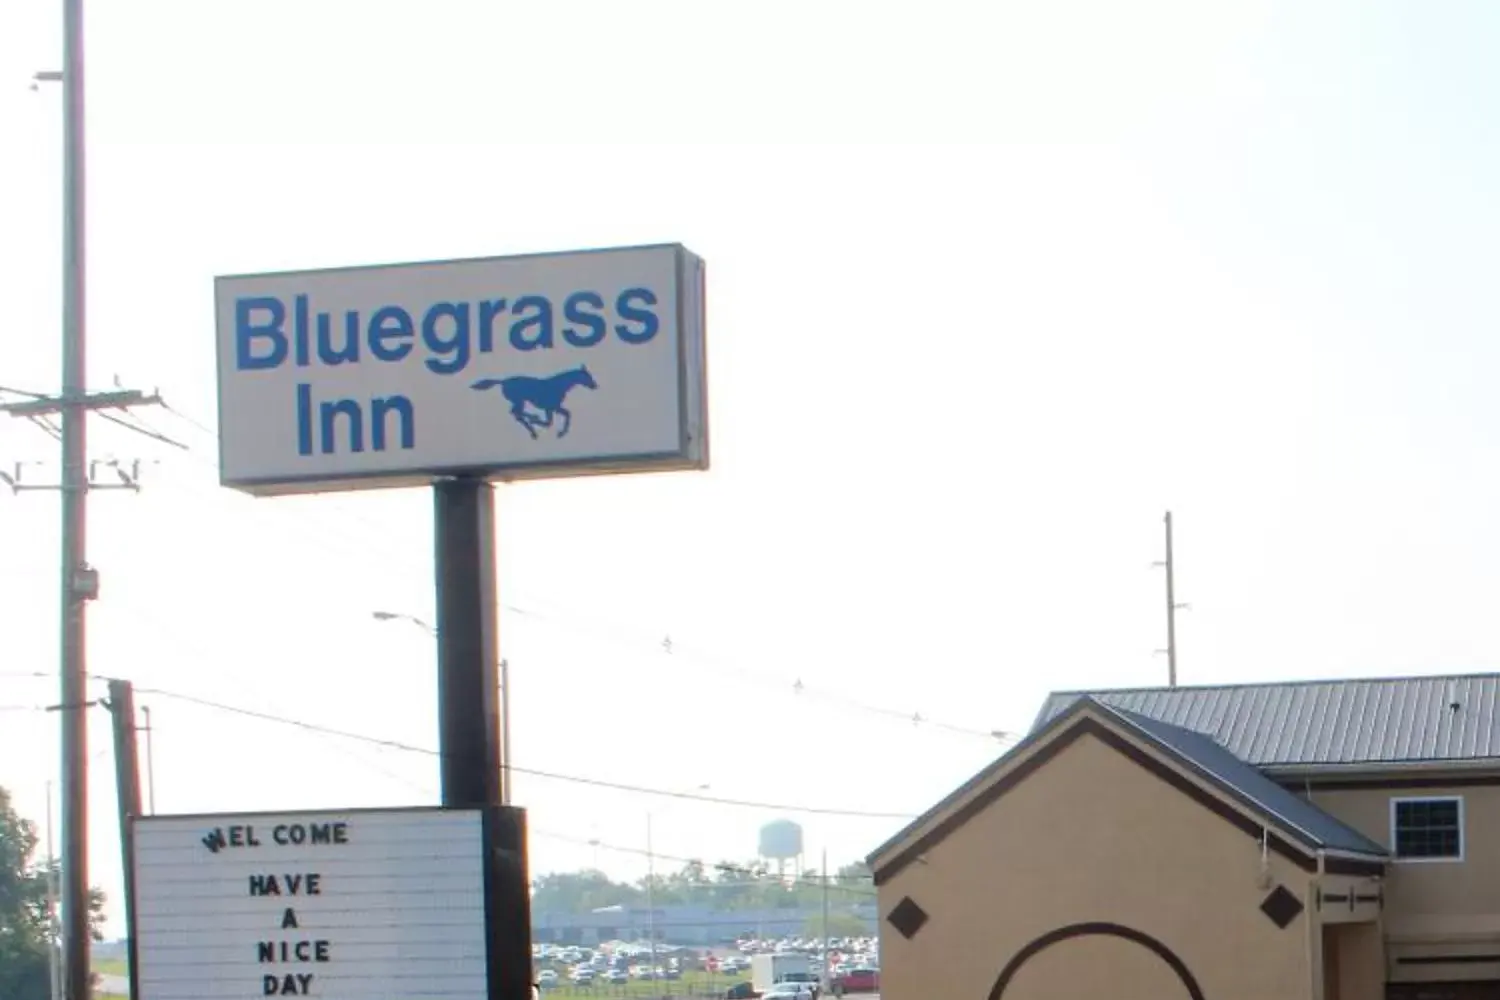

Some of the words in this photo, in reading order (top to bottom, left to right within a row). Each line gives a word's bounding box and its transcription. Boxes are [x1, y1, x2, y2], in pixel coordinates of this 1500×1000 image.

[235, 287, 660, 375] Bluegrass
[297, 383, 415, 456] Inn
[249, 873, 321, 896] HAVE
[280, 908, 299, 929] A
[258, 940, 330, 963] NICE
[263, 973, 314, 996] DAY
